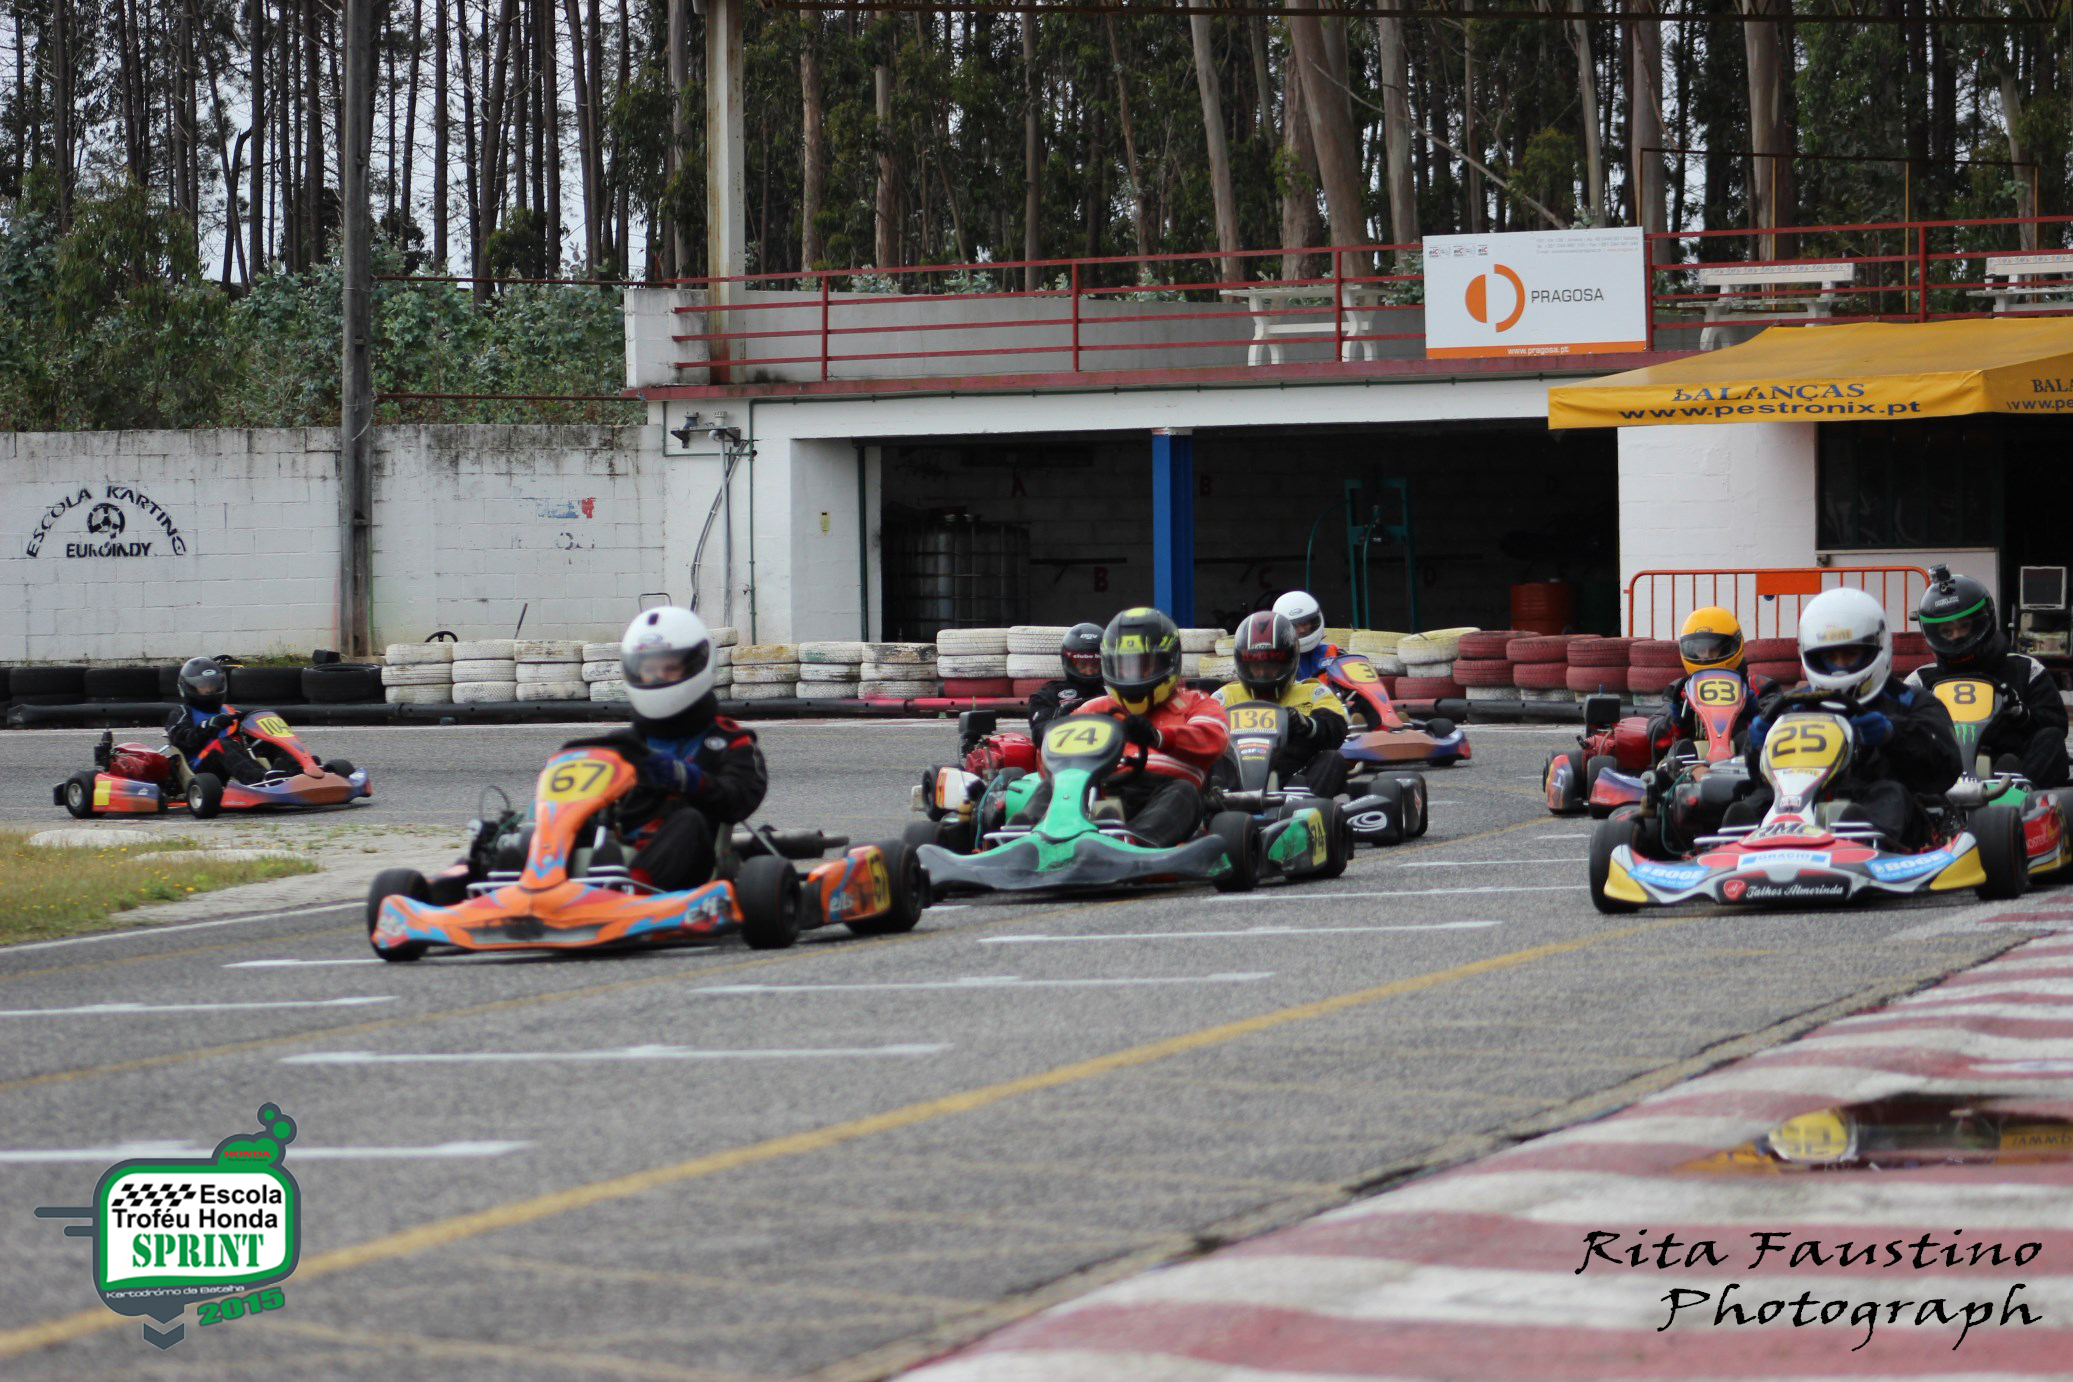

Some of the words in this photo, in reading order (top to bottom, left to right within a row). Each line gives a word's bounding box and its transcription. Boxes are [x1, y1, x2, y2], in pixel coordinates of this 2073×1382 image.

[1531, 288, 1604, 303] PRAGOSA
[1507, 346, 1570, 356] www.pragosa.pt
[1673, 384, 1865, 401] BALANÇAS
[1618, 400, 1920, 419] www.pestronix.pt
[26, 488, 92, 558] ESCOLA
[66, 541, 152, 558] EUROINDY
[1093, 566, 1109, 594] B
[1700, 681, 1736, 702] 63
[1953, 684, 1977, 705] 8
[1231, 710, 1275, 729] 136
[1055, 727, 1099, 748] 74
[1772, 724, 1827, 760] 25
[550, 763, 607, 793] 67
[1746, 885, 1782, 898] Talhos
[1784, 883, 1845, 896] Almerinda
